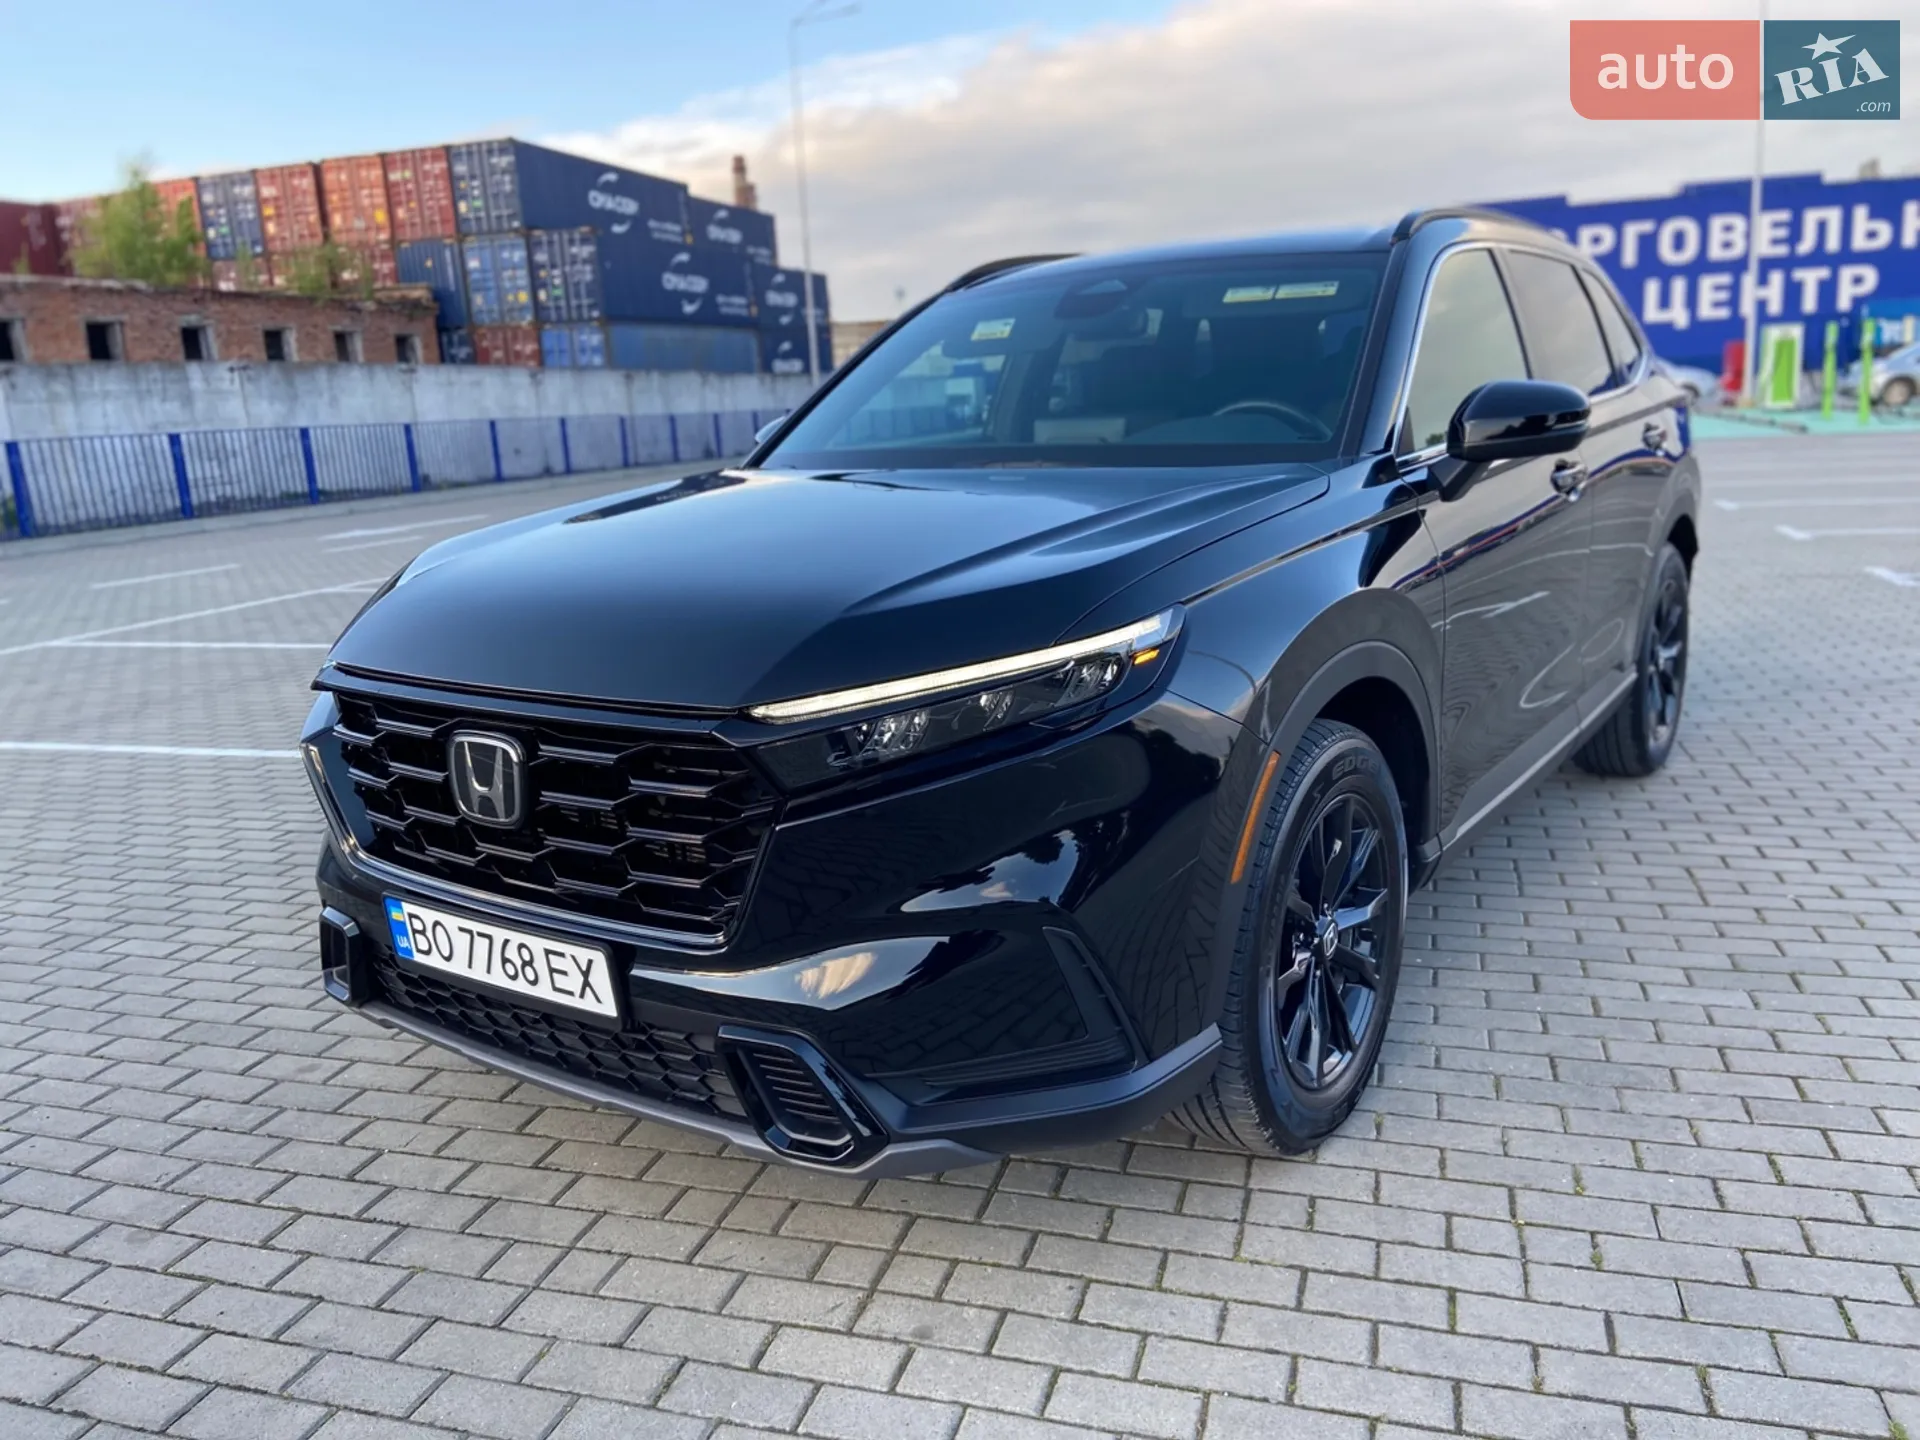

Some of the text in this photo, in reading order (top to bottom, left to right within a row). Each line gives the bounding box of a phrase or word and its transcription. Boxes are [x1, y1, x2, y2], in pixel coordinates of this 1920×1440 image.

[1548, 199, 1920, 268] РГОВЕЛЬ
[1643, 263, 1879, 330] ЦЕНТР
[396, 934, 411, 949] UA
[407, 911, 603, 1004] BO 7768 EX
